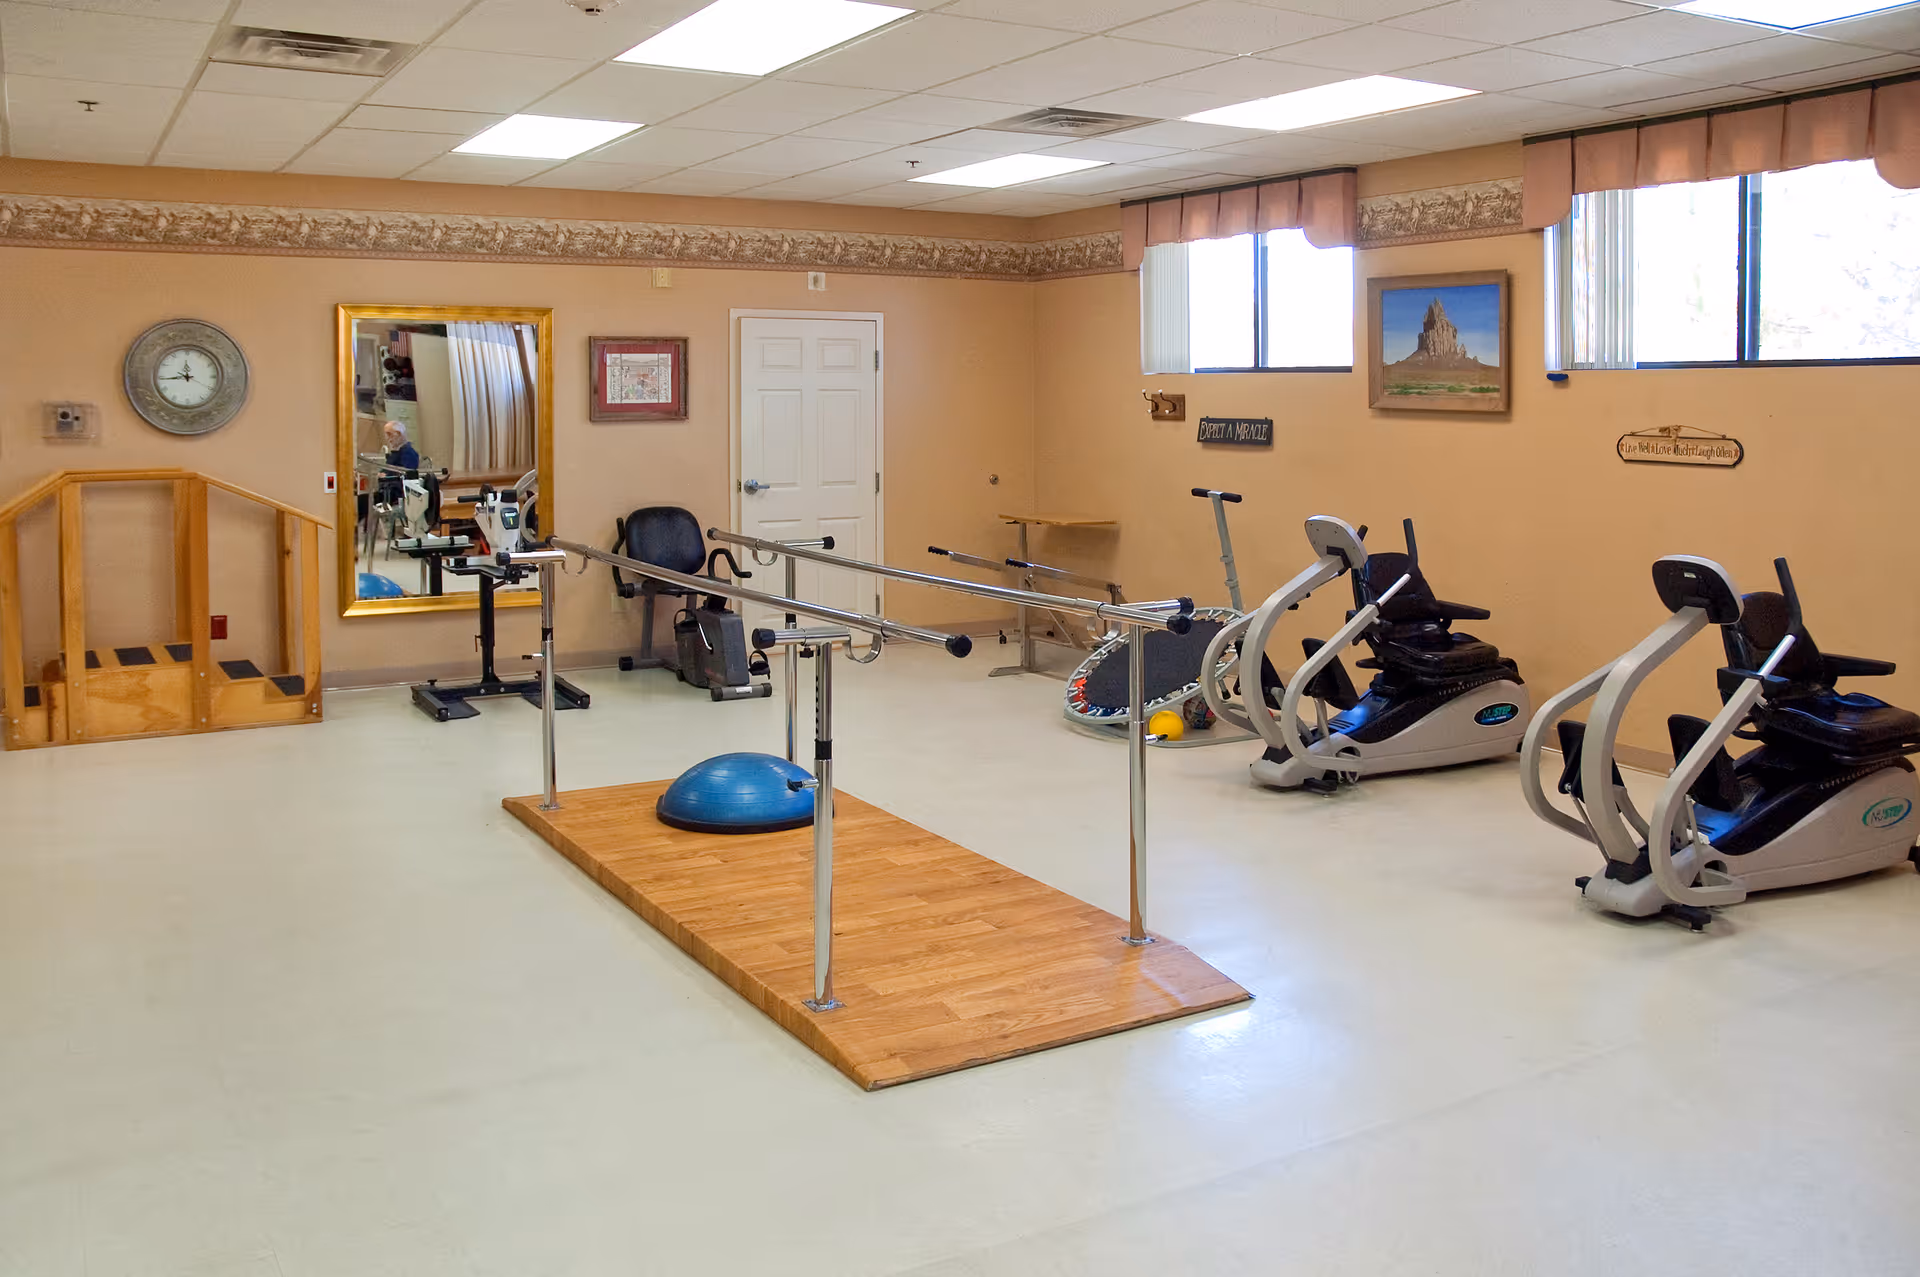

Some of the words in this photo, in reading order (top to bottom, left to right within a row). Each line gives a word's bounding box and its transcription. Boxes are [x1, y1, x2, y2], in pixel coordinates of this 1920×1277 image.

[1200, 421, 1226, 440] EXPECT
[1226, 423, 1233, 439] A
[1234, 422, 1269, 441] MIRACLE
[1655, 443, 1671, 455] Love
[1695, 445, 1715, 460] Laugh
[1716, 446, 1733, 459] Often
